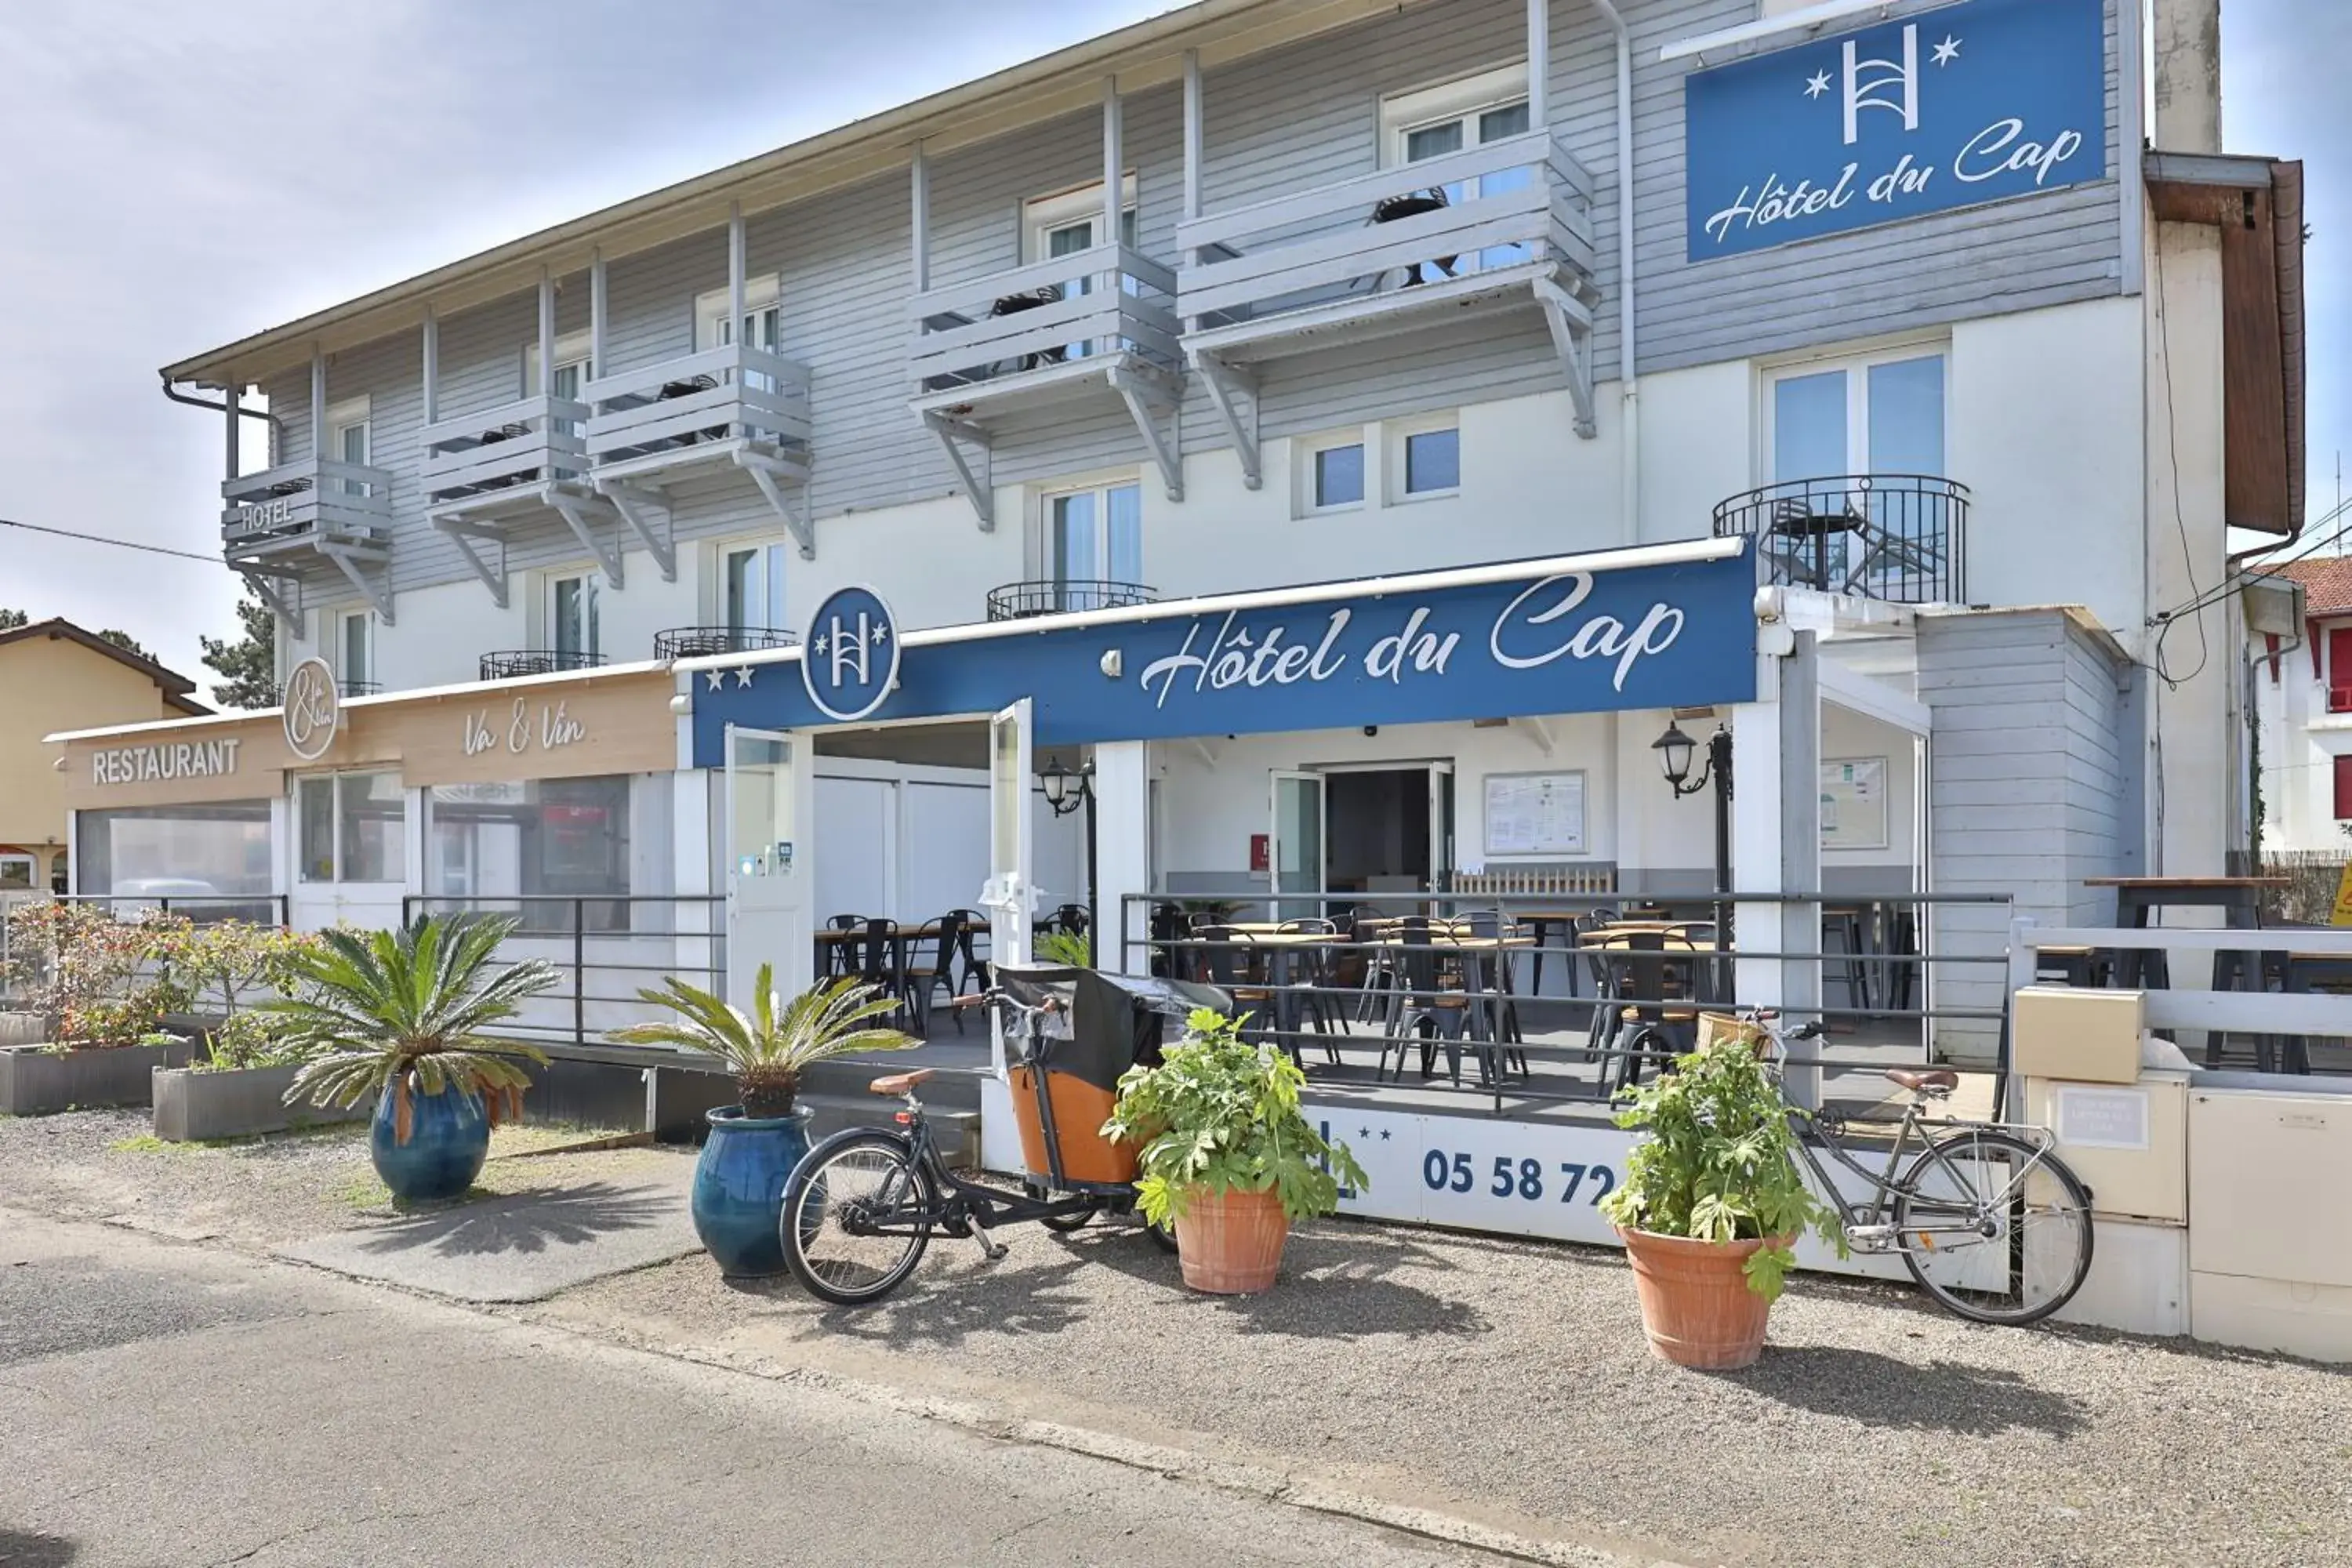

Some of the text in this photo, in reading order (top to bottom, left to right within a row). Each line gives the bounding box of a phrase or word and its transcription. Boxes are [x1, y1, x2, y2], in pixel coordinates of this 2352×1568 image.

[1705, 118, 2082, 243] Hôtel du Cap
[241, 499, 292, 531] HOTEL
[1141, 571, 1684, 709] Hôtel du Cap
[466, 697, 586, 755] Va & Vin
[93, 739, 239, 785] RESTAURANT
[1423, 1149, 1615, 1206] 05 58 72
